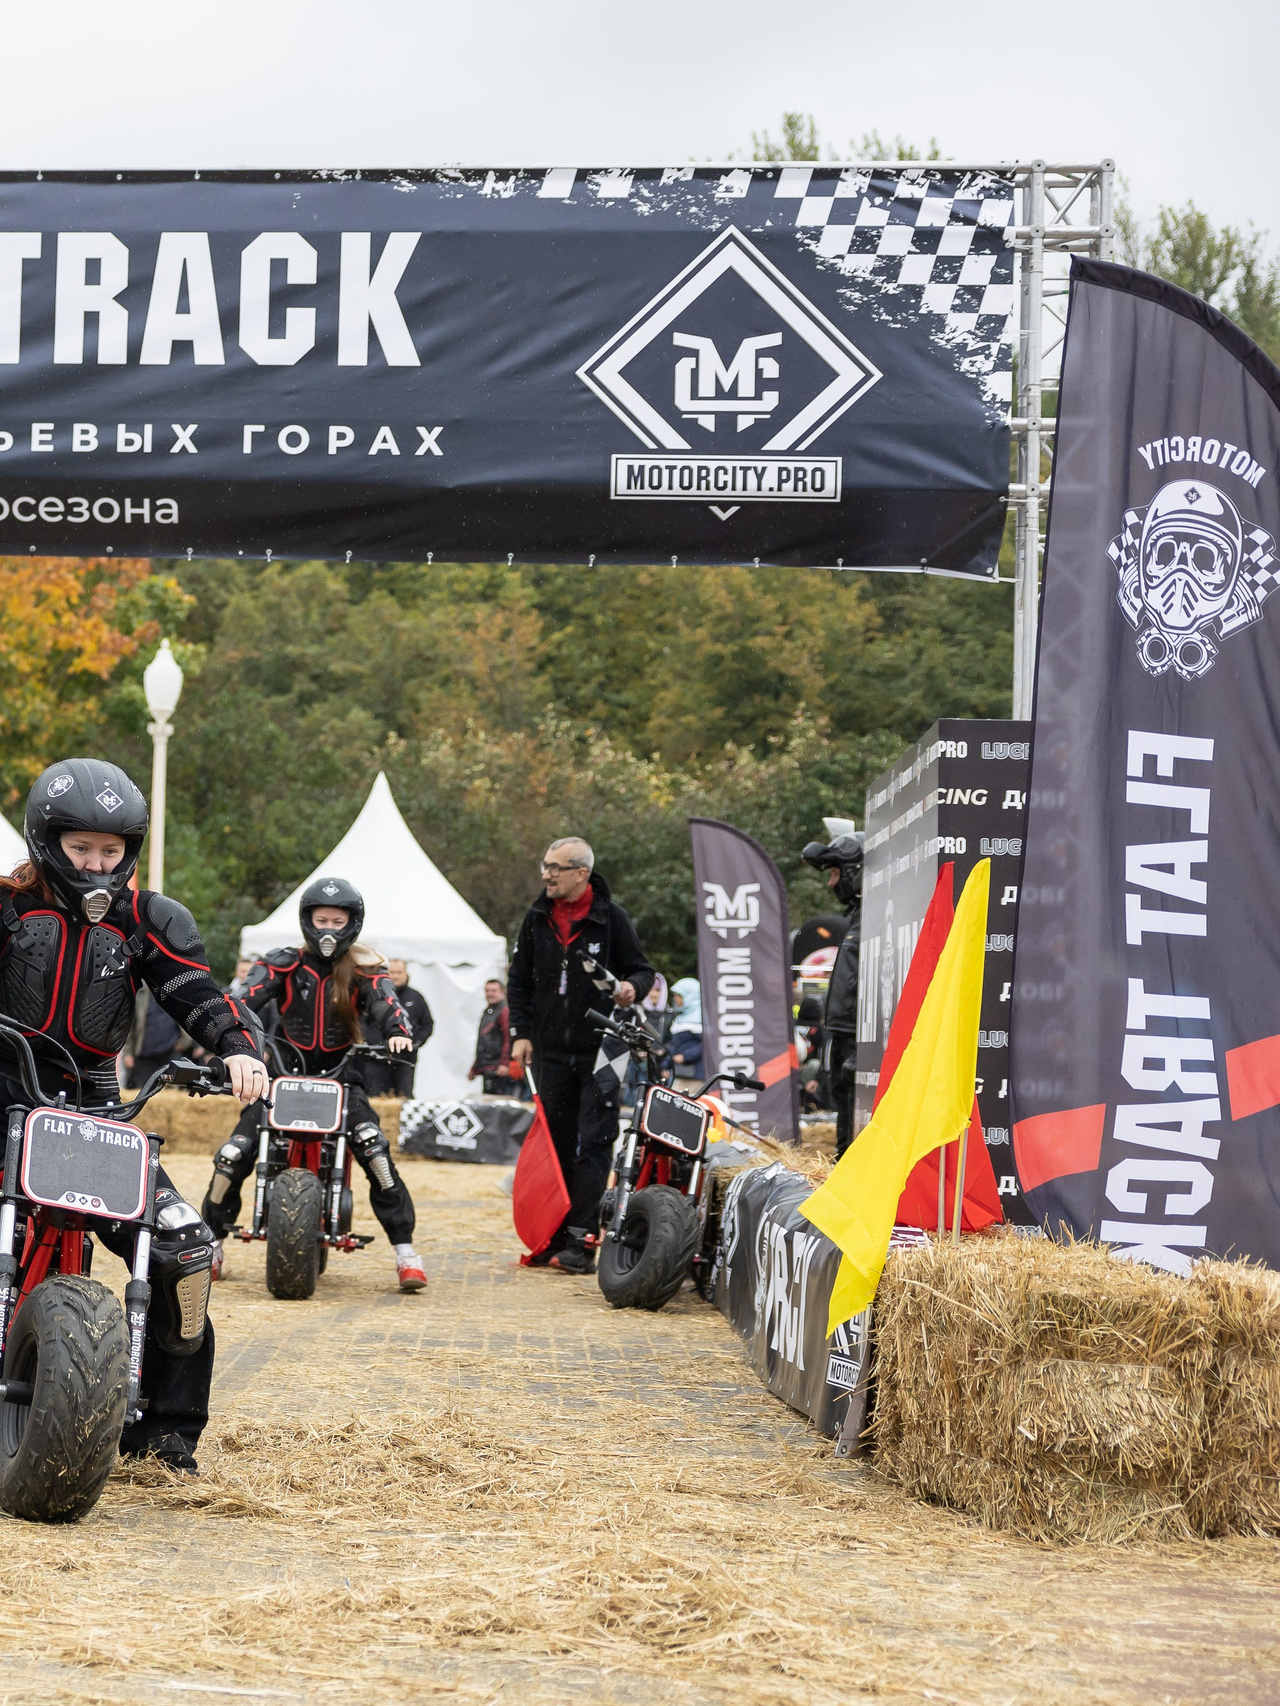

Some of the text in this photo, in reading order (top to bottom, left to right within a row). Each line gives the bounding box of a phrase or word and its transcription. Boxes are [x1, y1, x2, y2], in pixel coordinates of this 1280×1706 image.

[242, 424, 444, 456] ГОРАХ
[626, 464, 826, 493] MOTORCITY.PRO
[281, 1082, 338, 1094] FLAT TRACK
[656, 1090, 704, 1118] FLAT TRACK
[43, 1118, 140, 1150] FLAT TRACK
